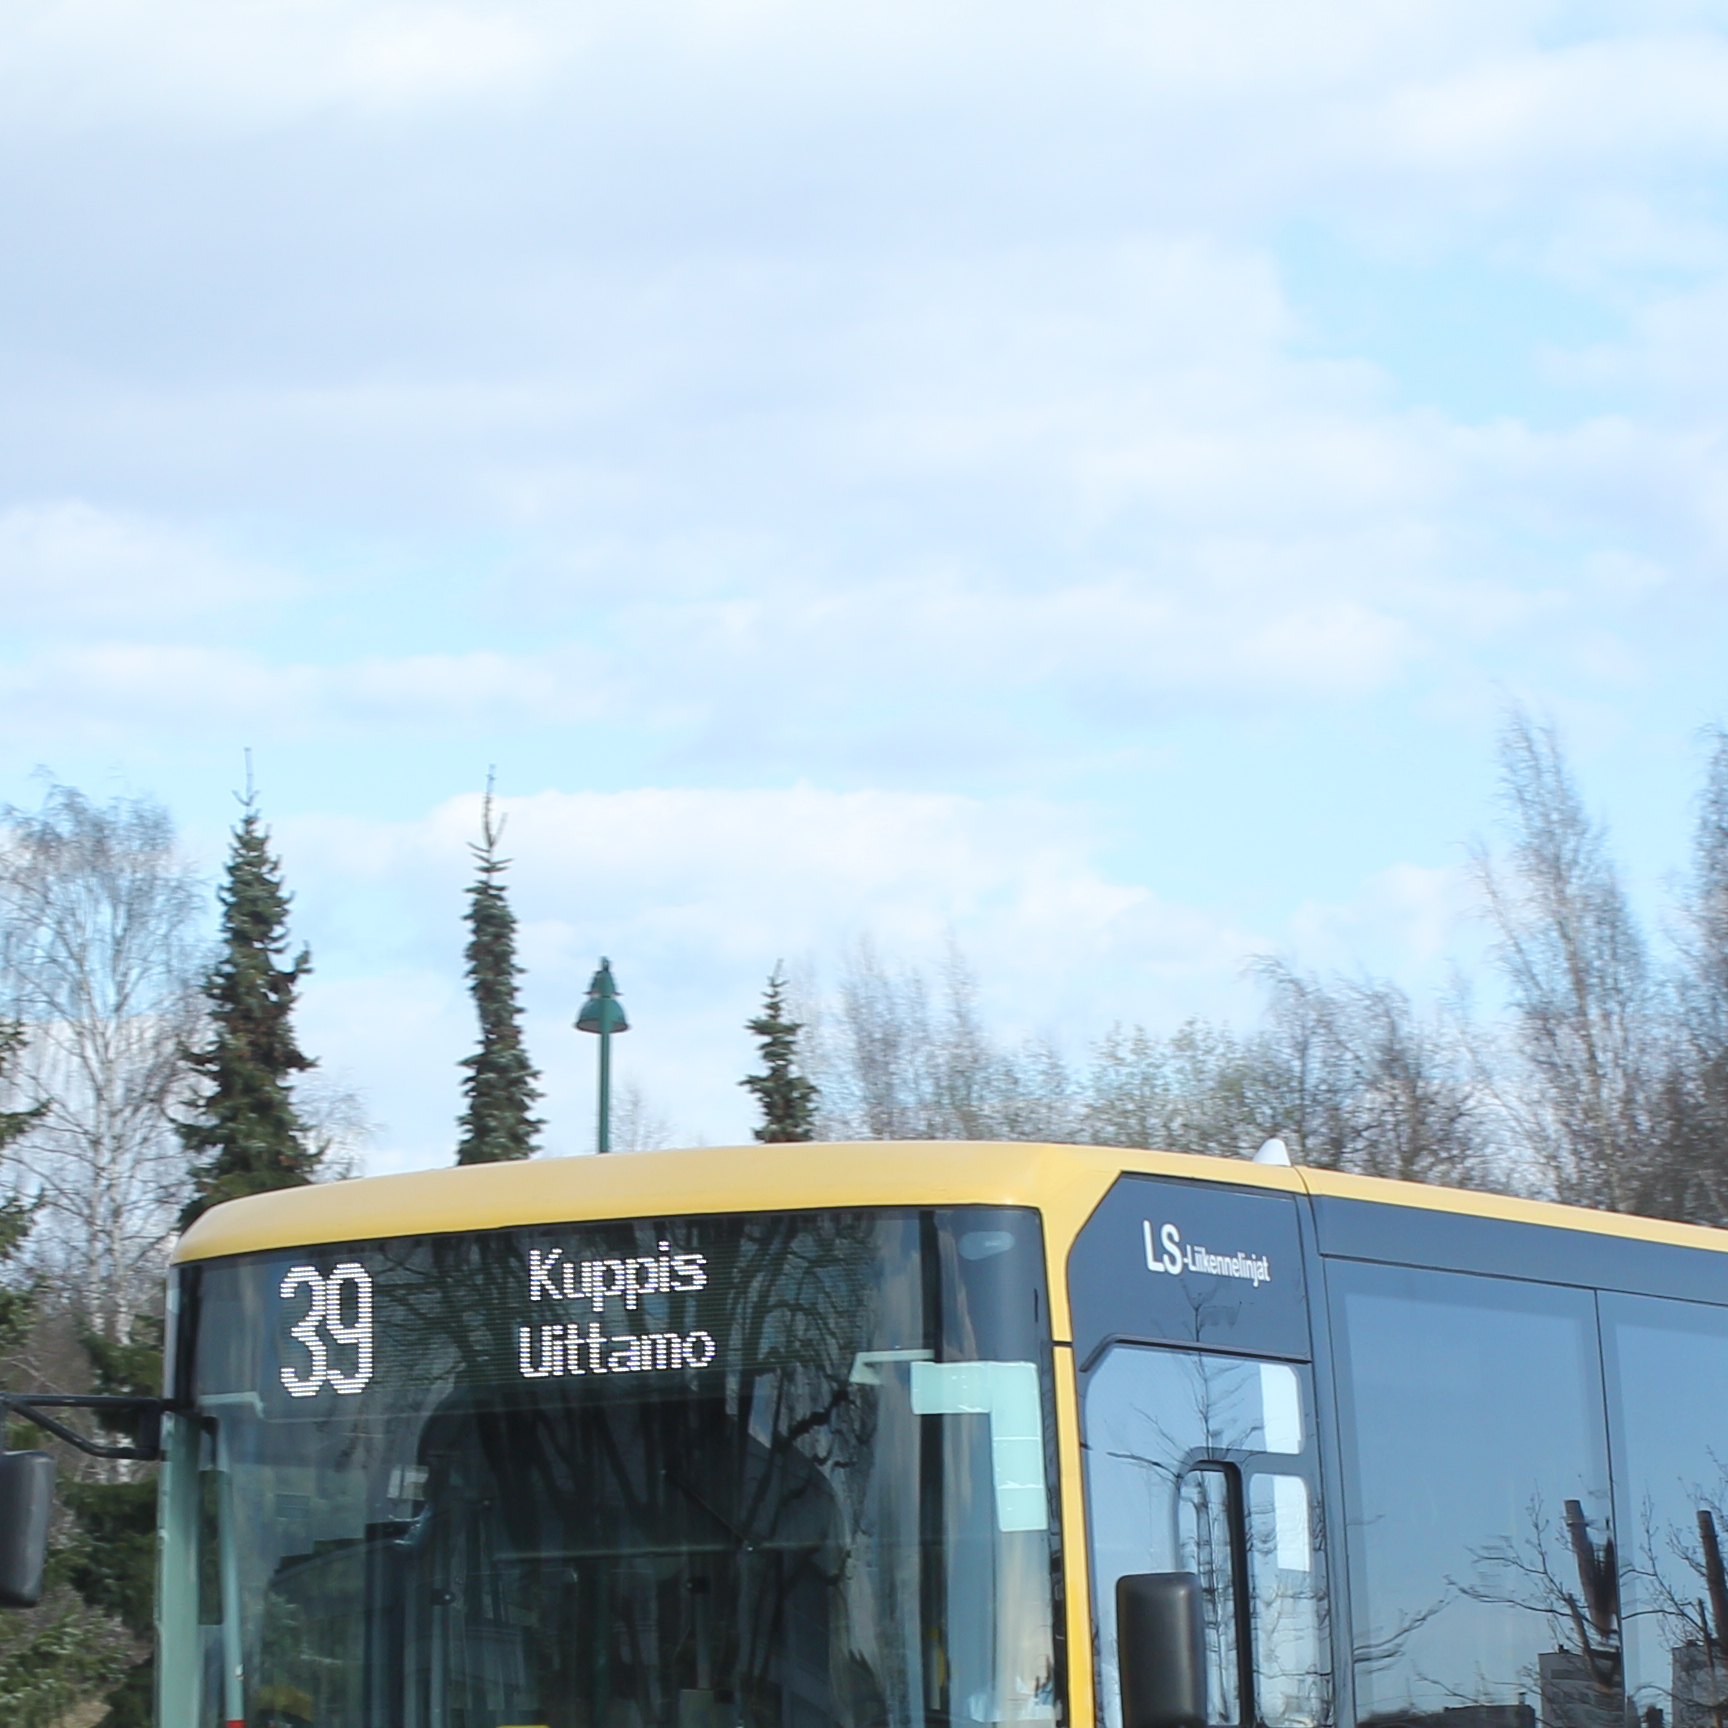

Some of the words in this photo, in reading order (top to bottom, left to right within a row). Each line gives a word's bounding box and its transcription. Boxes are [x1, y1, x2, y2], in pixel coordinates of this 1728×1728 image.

[528, 1240, 707, 1312] Kuppis
[1142, 1219, 1271, 1287] LS-Liikennelinjat
[279, 1262, 373, 1397] 39
[518, 1322, 717, 1377] Uittamo
